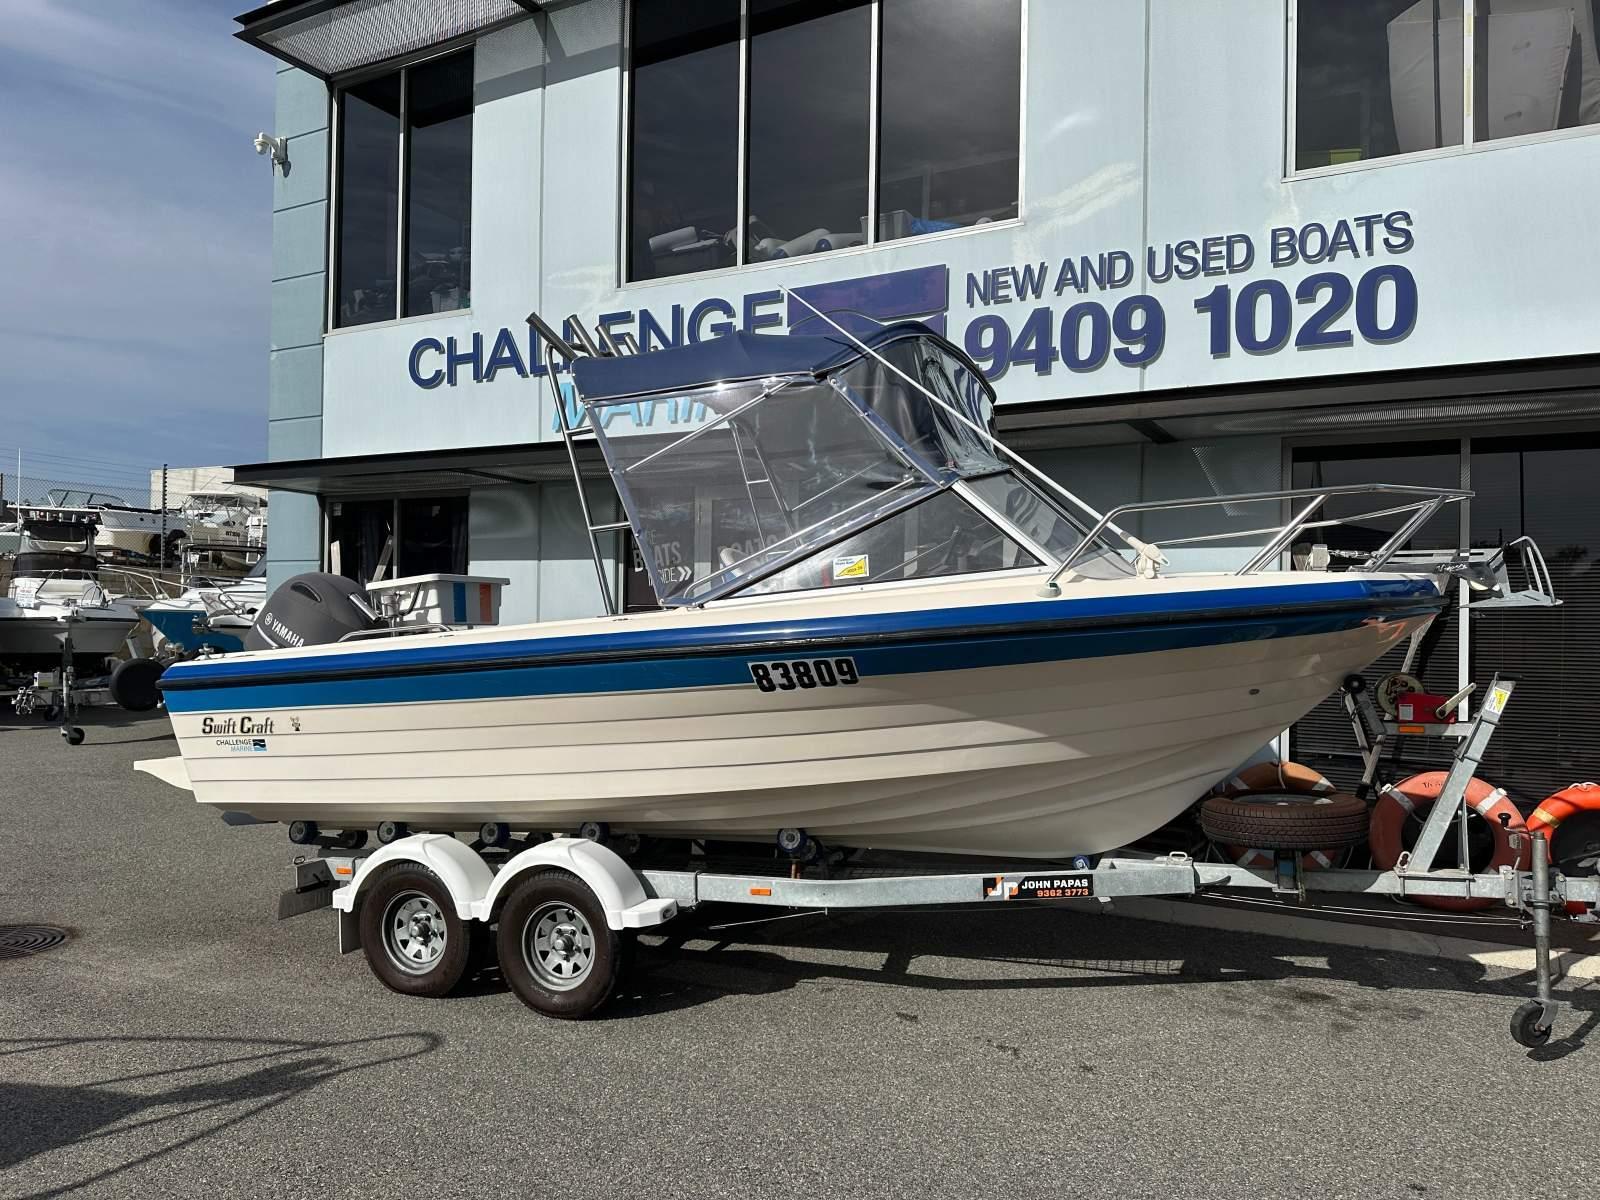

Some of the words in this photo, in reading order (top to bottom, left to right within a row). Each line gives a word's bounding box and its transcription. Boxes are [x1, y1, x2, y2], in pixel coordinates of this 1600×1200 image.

[966, 261, 1049, 308] NEW
[1054, 249, 1134, 297] AND
[1147, 232, 1255, 285] USED
[1270, 210, 1415, 268] BOATS
[964, 294, 1166, 383] 9409
[1194, 264, 1418, 360] 1020
[271, 618, 305, 648] YAMAHA
[750, 658, 859, 693] 83809
[202, 716, 237, 735] Swift
[240, 716, 274, 735] Craft
[216, 738, 253, 746] CHALLENGE
[1021, 880, 1051, 889] JOHN
[1053, 878, 1089, 888] PAPAS
[1064, 888, 1089, 896] 3773
